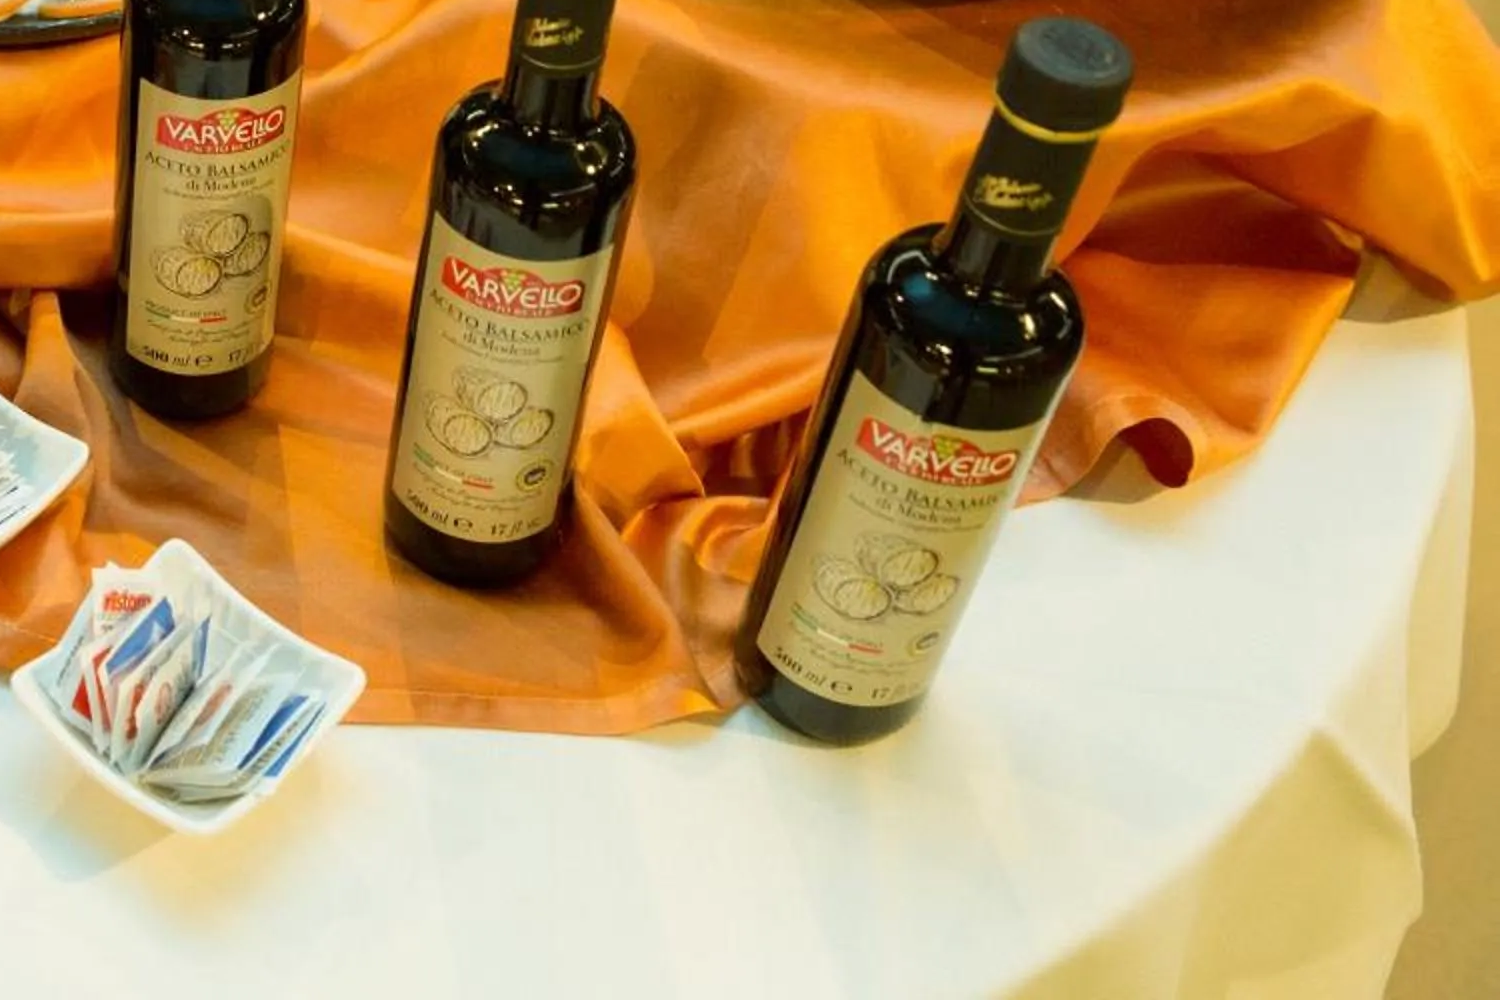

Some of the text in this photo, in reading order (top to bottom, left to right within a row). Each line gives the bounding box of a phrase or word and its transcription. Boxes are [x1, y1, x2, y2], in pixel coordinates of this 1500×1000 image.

[165, 109, 284, 145] VARVELLO
[145, 151, 200, 175] ACETO
[451, 259, 581, 309] VARVELLO
[871, 420, 1017, 478] VARVELLO
